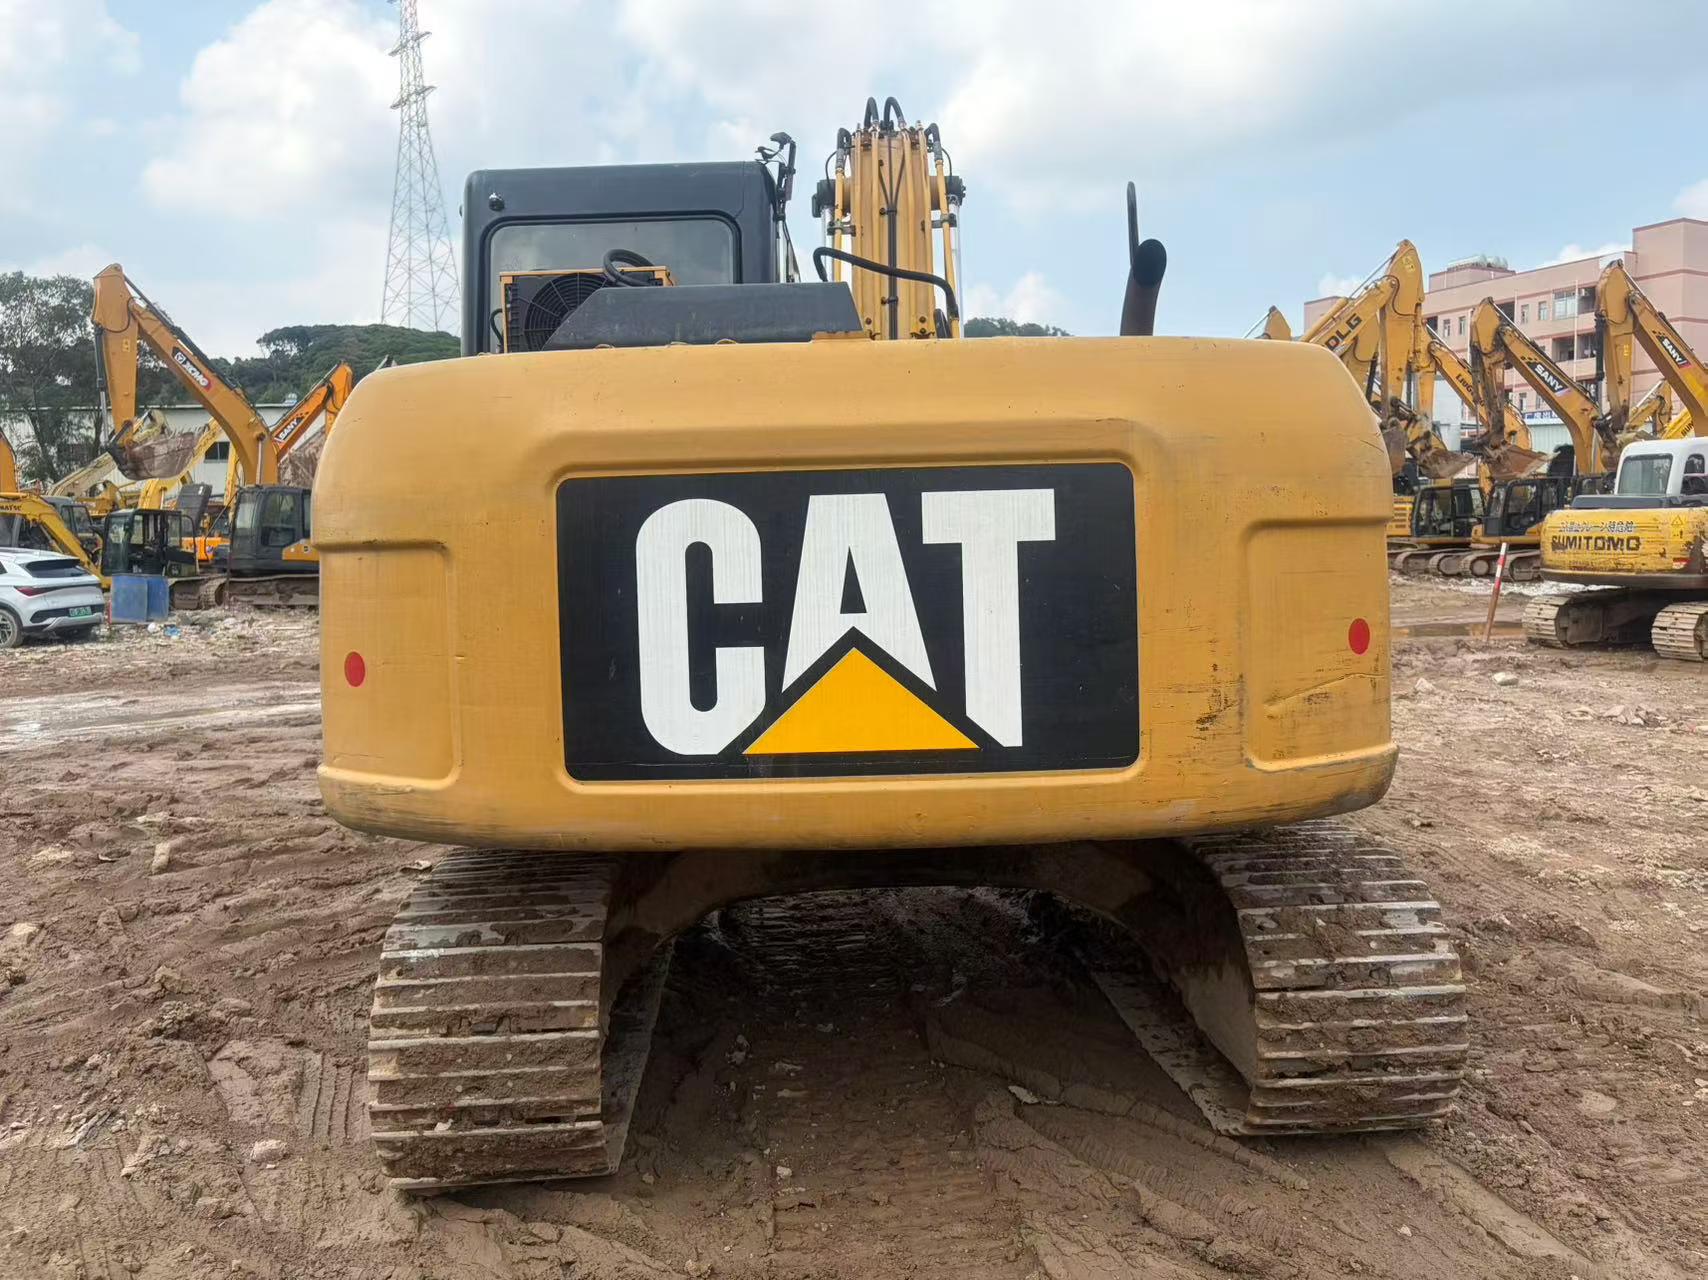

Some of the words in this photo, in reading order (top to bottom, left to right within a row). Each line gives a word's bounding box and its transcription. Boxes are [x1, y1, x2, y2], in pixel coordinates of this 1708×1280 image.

[1662, 338, 1682, 361] SANY
[182, 360, 209, 386] XCMG
[1535, 364, 1563, 391] SANY
[279, 418, 298, 440] SANY
[1552, 535, 1641, 551] SUMITOMO
[636, 488, 1056, 755] CAT
